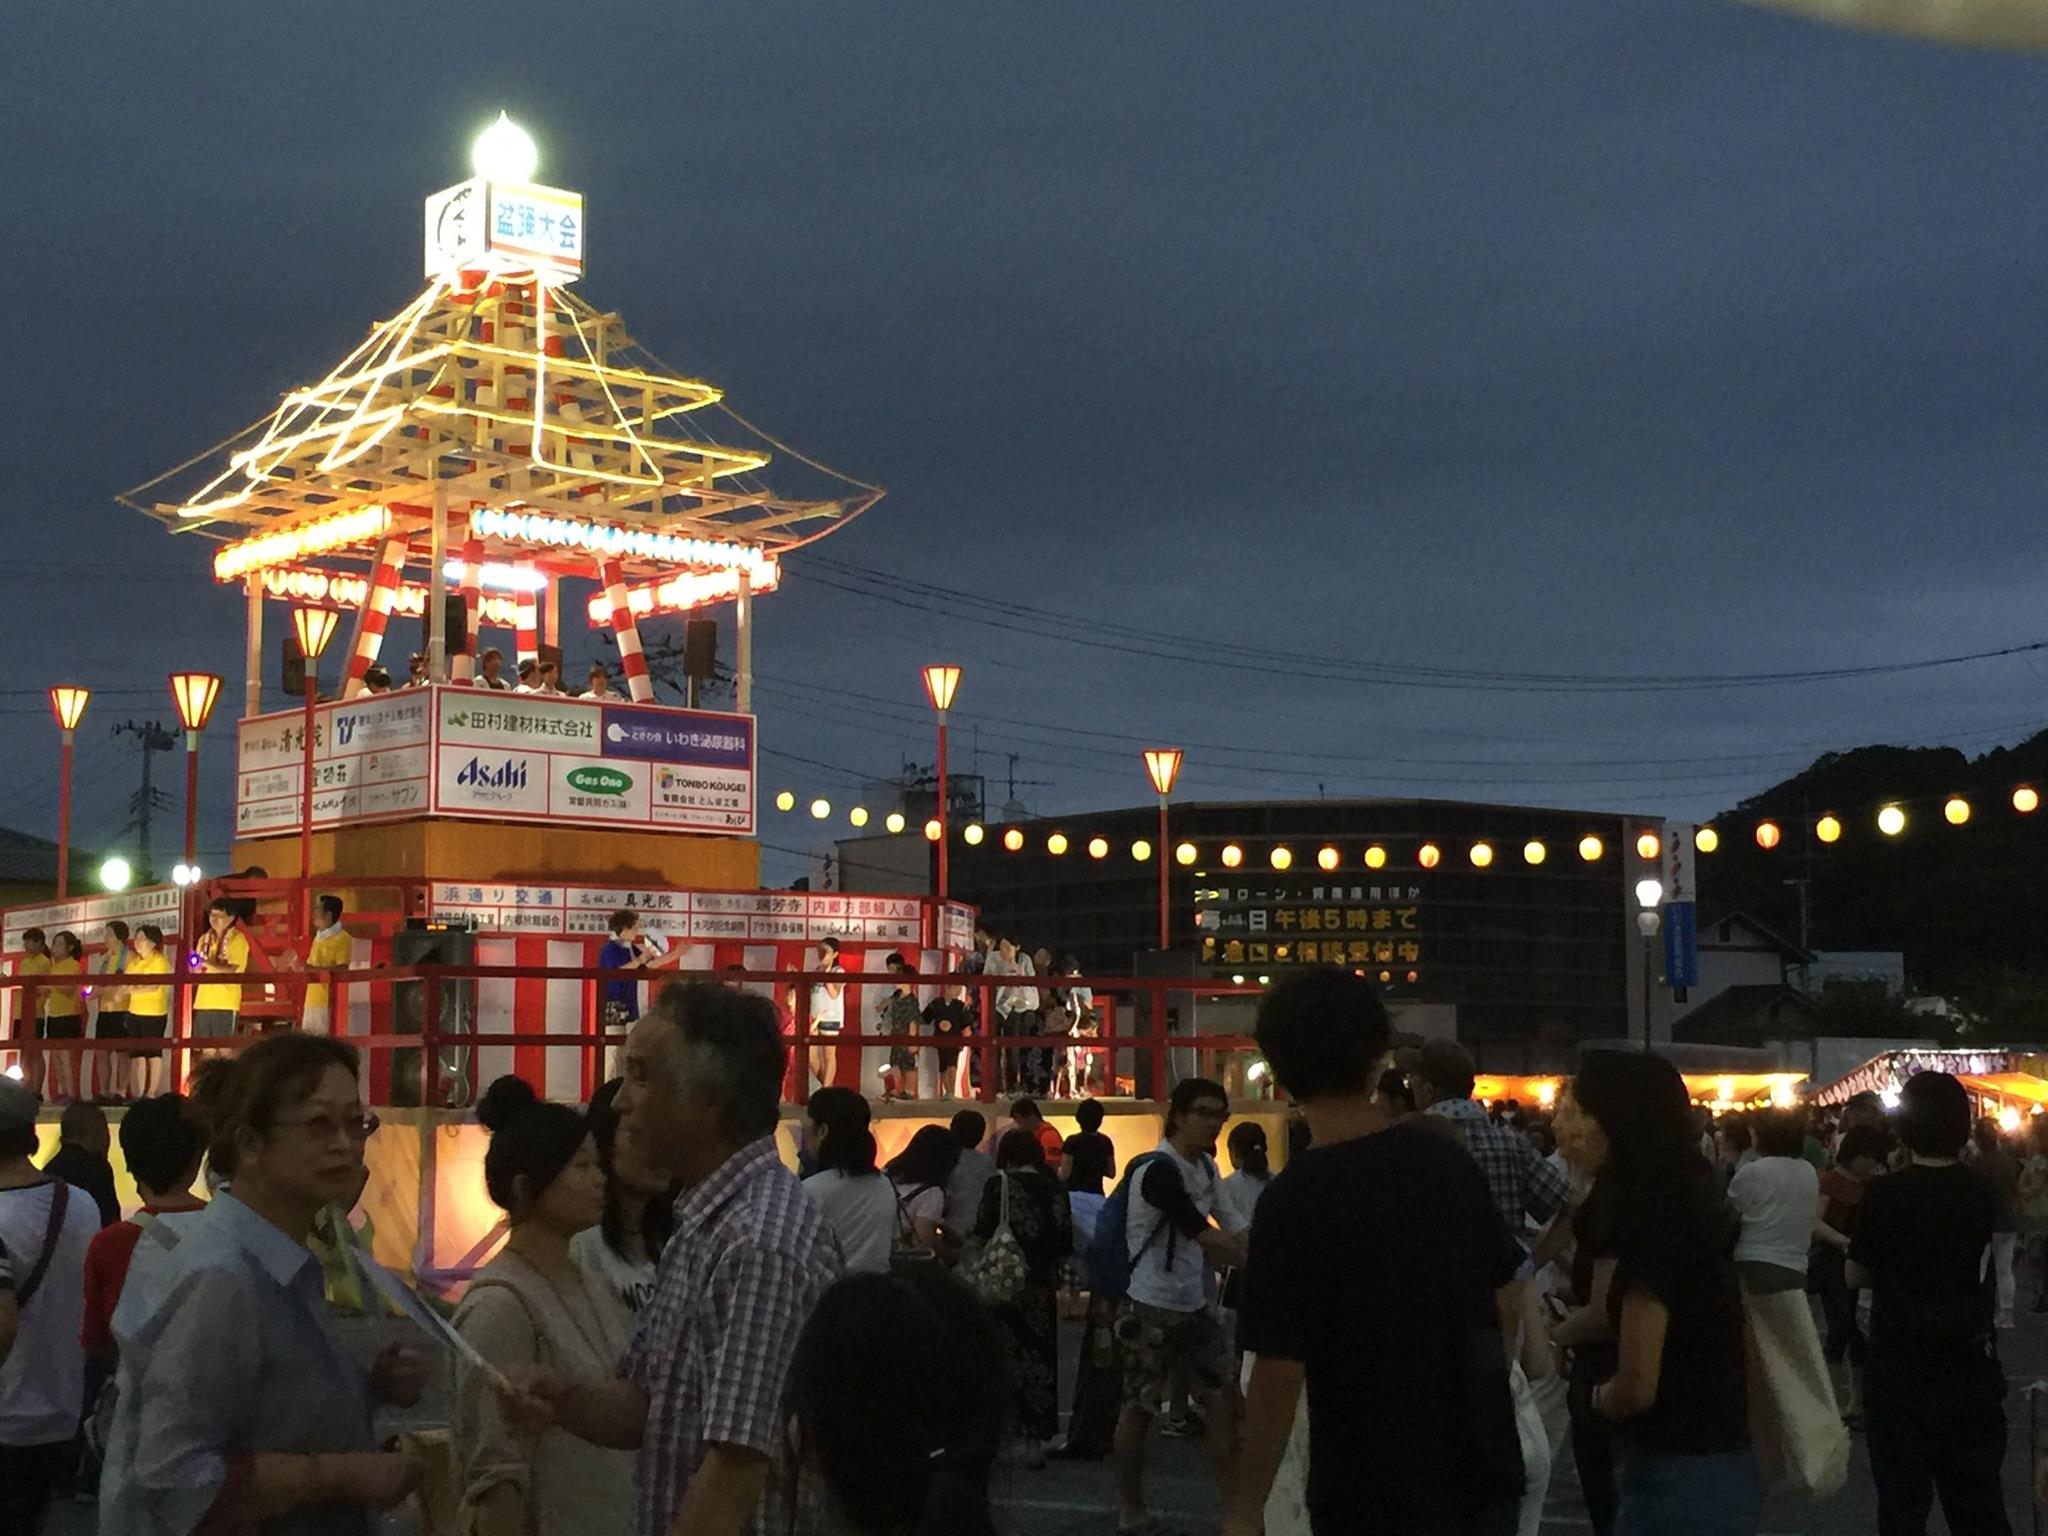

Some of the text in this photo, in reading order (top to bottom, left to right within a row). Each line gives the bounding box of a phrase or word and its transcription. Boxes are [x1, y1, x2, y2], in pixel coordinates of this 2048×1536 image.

[471, 712, 593, 738] 田村建材株式会社
[457, 756, 527, 789] Asahi
[575, 773, 623, 788] Gas One
[675, 778, 747, 793] TONBO KOUGEI
[443, 886, 554, 906] 浜通り交通
[812, 901, 917, 919] 内郷方部婦人会
[1274, 907, 1418, 930] 午後5時まで
